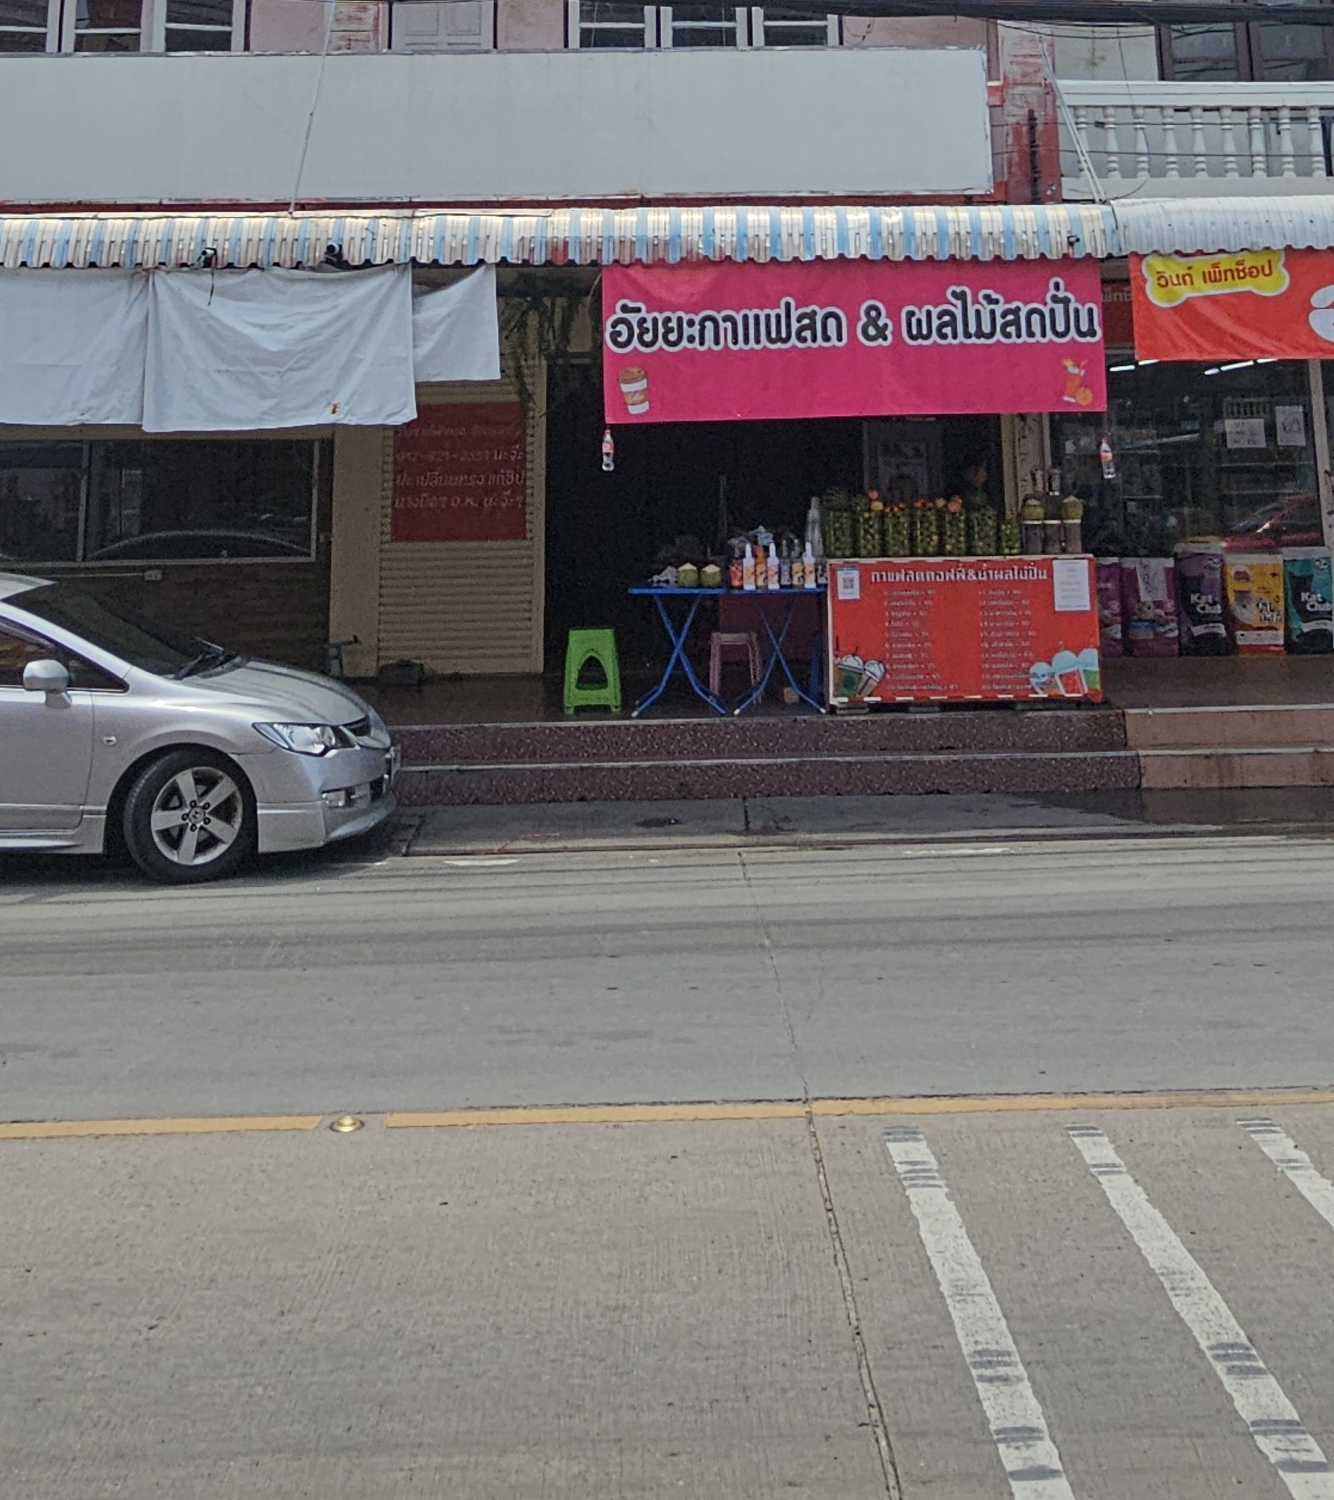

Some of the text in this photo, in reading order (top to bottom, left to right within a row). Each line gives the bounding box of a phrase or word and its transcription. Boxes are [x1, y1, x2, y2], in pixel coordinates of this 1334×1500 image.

[859, 299, 892, 347] &
[902, 277, 1099, 346] ผลไม้สดปั่น
